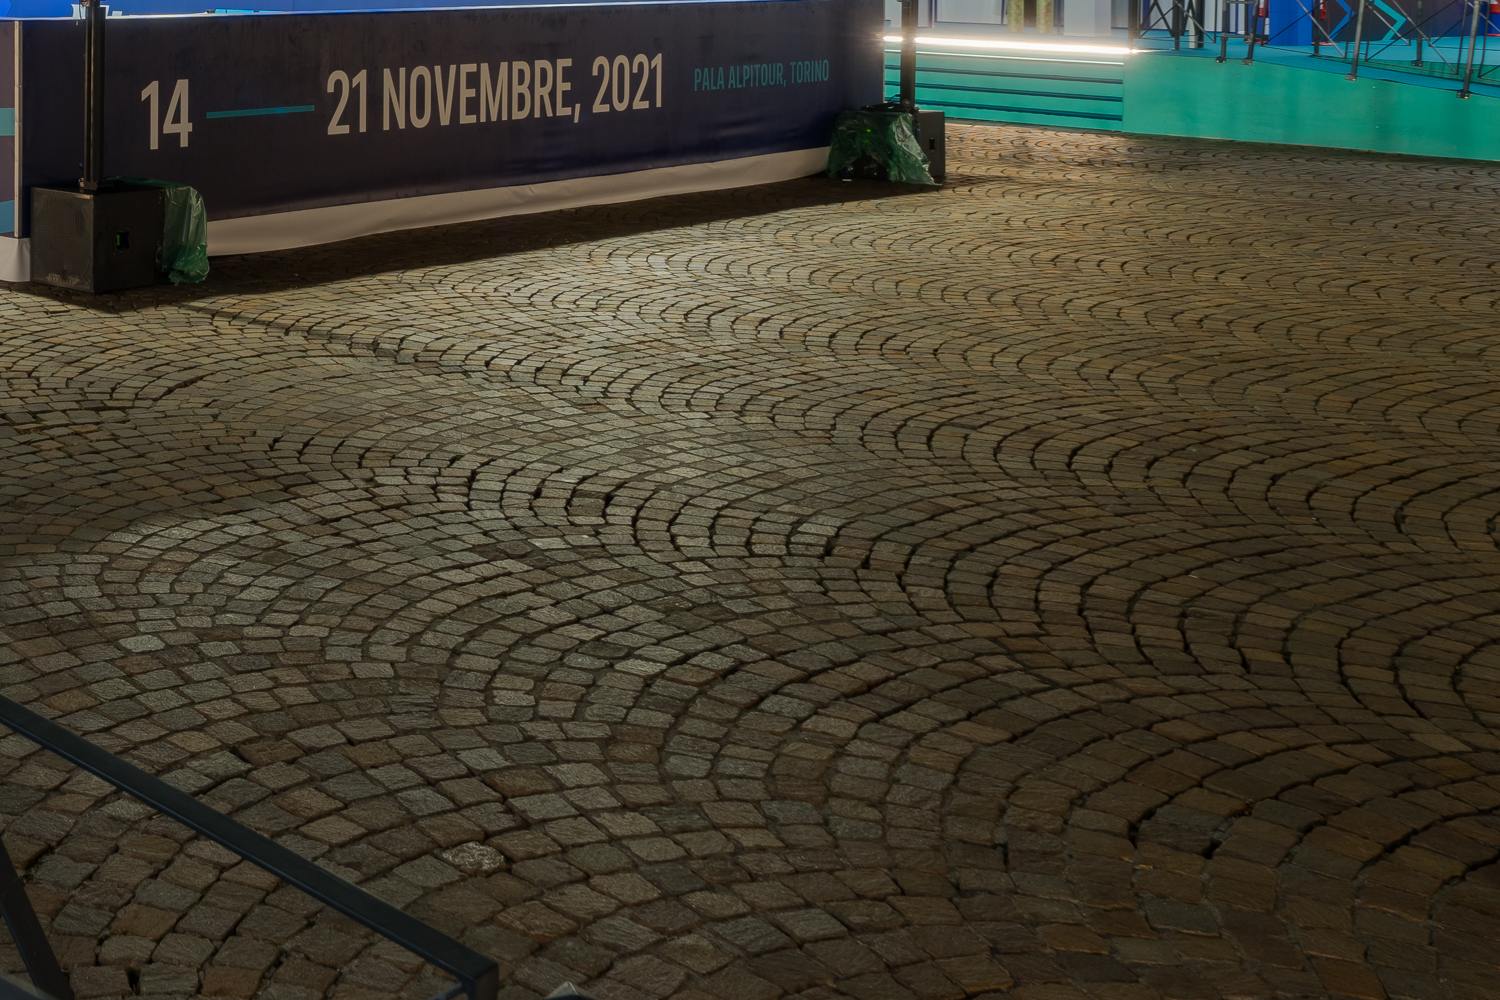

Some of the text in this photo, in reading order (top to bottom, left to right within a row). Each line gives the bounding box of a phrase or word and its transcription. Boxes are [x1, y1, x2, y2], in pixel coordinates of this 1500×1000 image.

[141, 53, 662, 149] 14 21 NOVEMBRE, 2021
[694, 59, 829, 91] PALA ALPITOUR, TORINO
